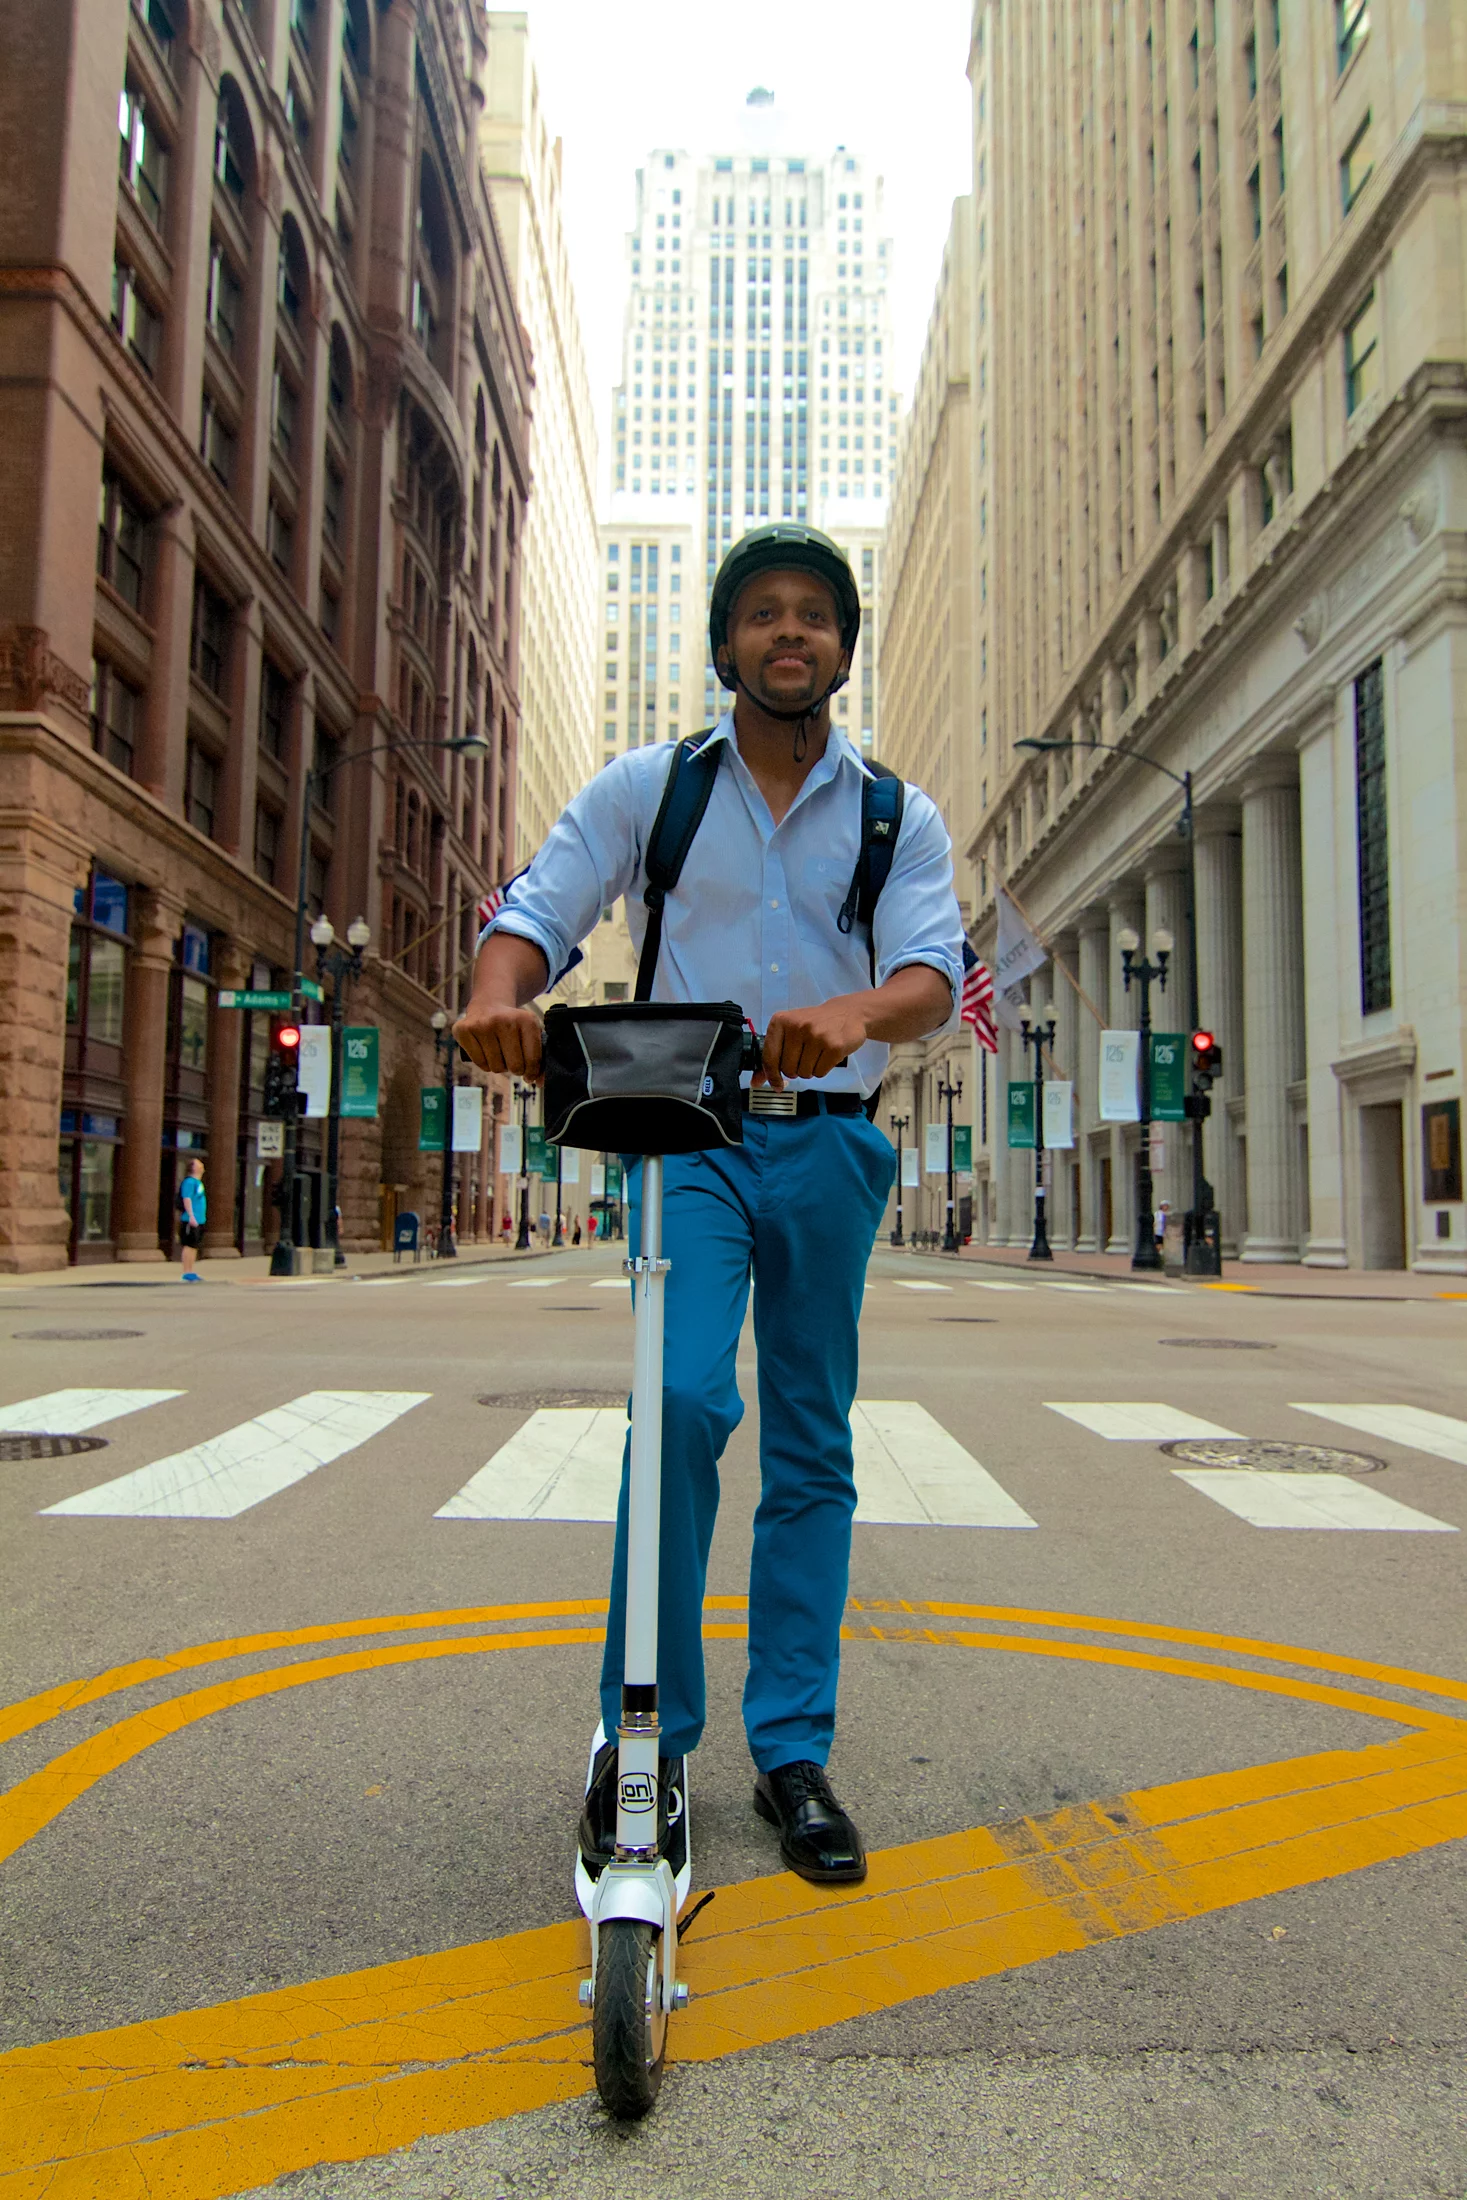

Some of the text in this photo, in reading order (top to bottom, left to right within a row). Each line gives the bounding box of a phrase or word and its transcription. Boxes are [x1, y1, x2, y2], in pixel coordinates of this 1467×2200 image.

[243, 993, 279, 1006] Adams
[346, 1039, 368, 1059] 125
[1106, 1043, 1124, 1062] 125
[1154, 1044, 1175, 1064] 125
[260, 1125, 280, 1133] ONE
